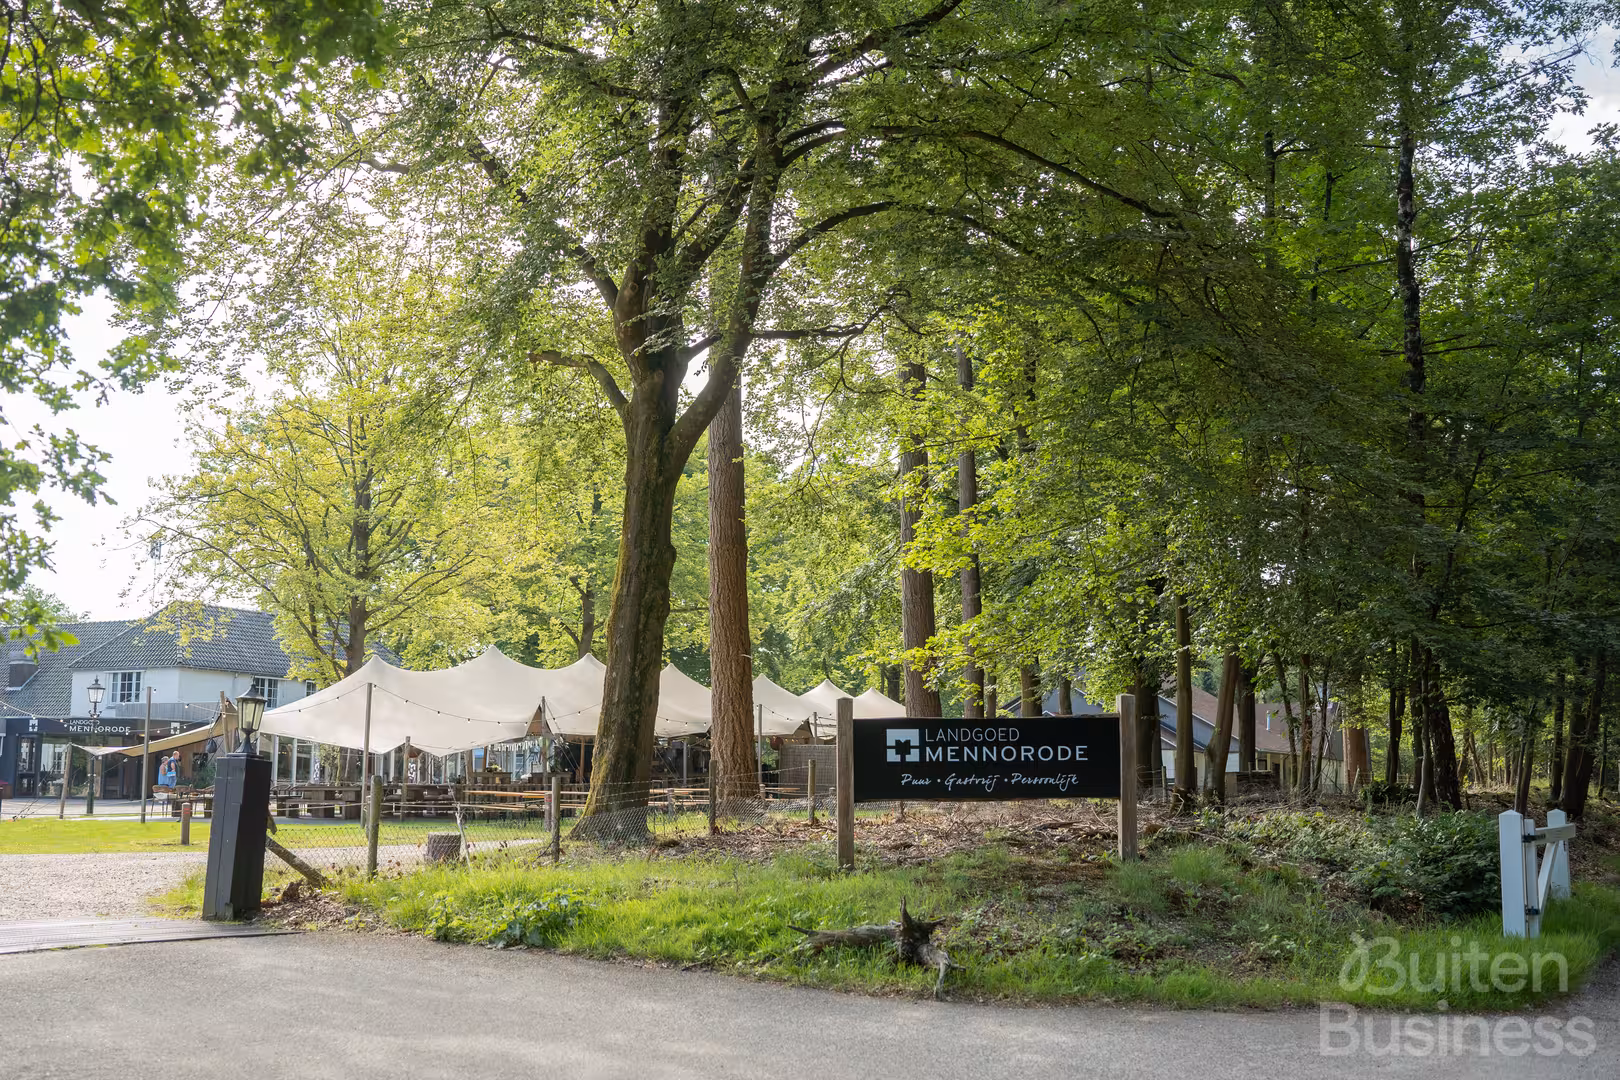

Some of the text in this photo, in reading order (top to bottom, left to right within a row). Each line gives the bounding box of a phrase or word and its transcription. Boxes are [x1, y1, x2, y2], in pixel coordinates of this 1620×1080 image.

[925, 727, 1020, 742] LANDGOED
[925, 745, 1089, 762] MENNORODE
[901, 772, 1080, 792] Puur Gastvrij Persoonlijk
